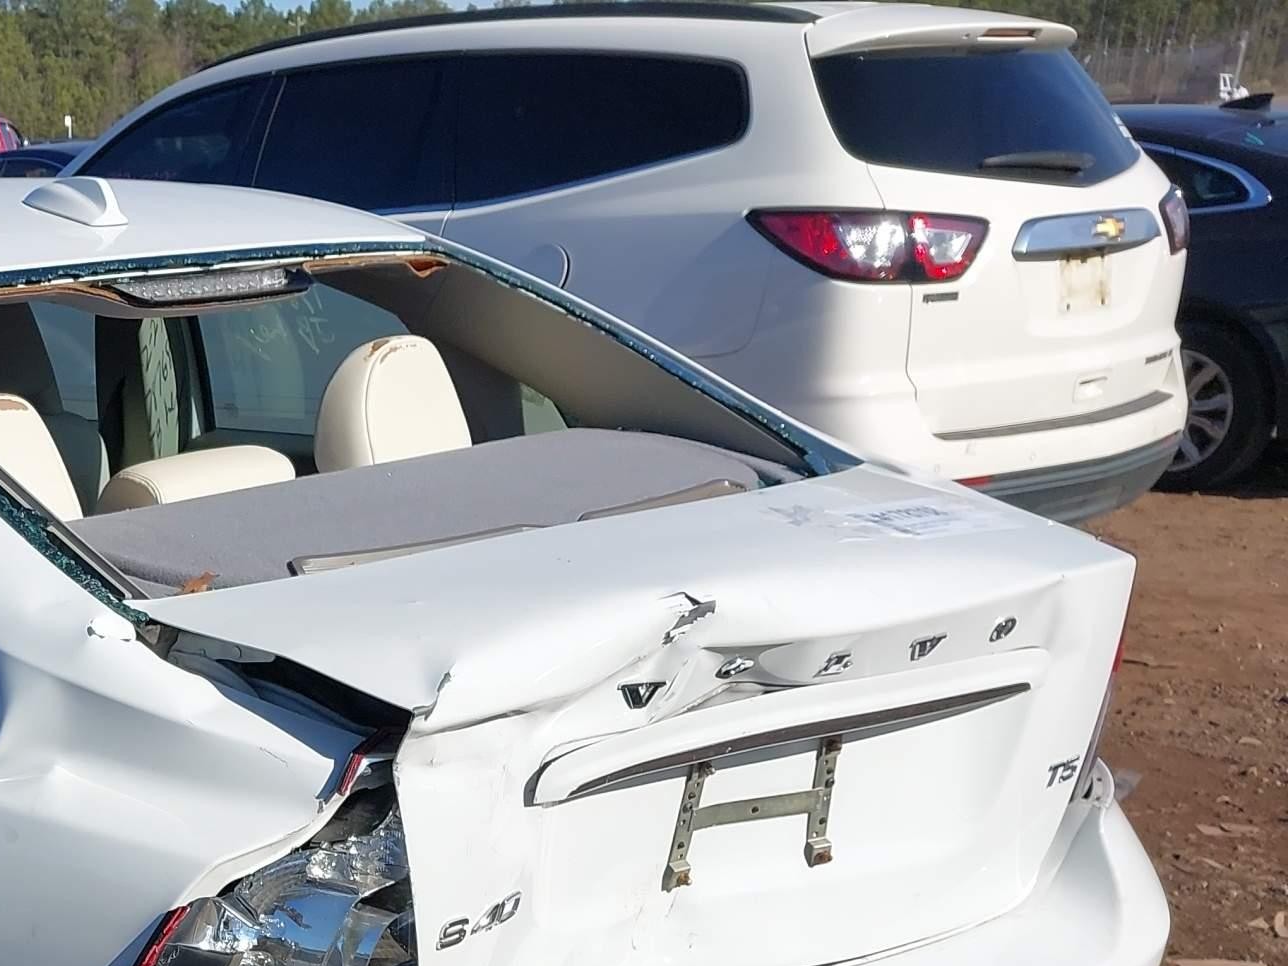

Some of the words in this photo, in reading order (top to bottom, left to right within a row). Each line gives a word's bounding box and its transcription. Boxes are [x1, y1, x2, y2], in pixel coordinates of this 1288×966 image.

[617, 616, 1017, 710] VOLVO
[1046, 756, 1080, 788] T5
[436, 891, 522, 951] S40
